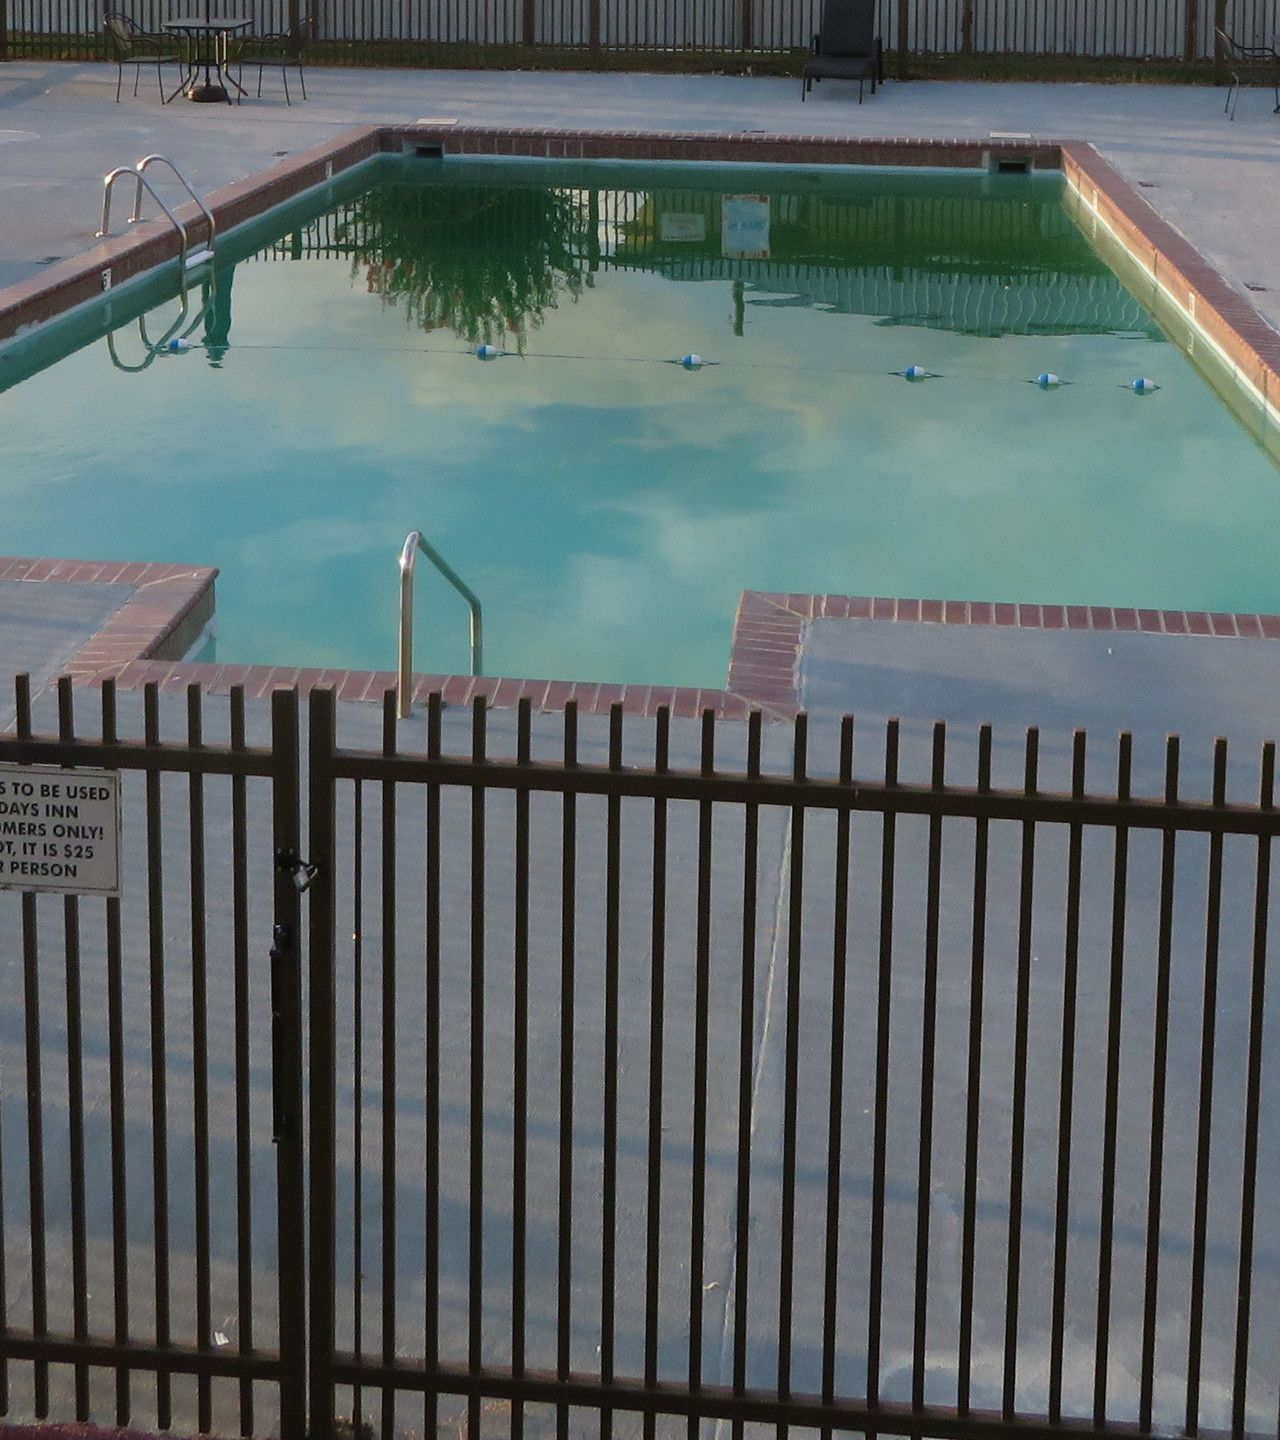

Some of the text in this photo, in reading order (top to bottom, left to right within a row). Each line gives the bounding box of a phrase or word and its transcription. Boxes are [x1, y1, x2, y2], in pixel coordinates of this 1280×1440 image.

[11, 782, 34, 796] TO
[40, 784, 60, 799] BE
[66, 786, 110, 801] USED
[45, 804, 79, 818] INN
[53, 824, 104, 840] ONLY!
[23, 842, 37, 856] IT
[43, 843, 58, 857] IS
[63, 843, 94, 860] $25
[10, 861, 78, 878] PERSON
